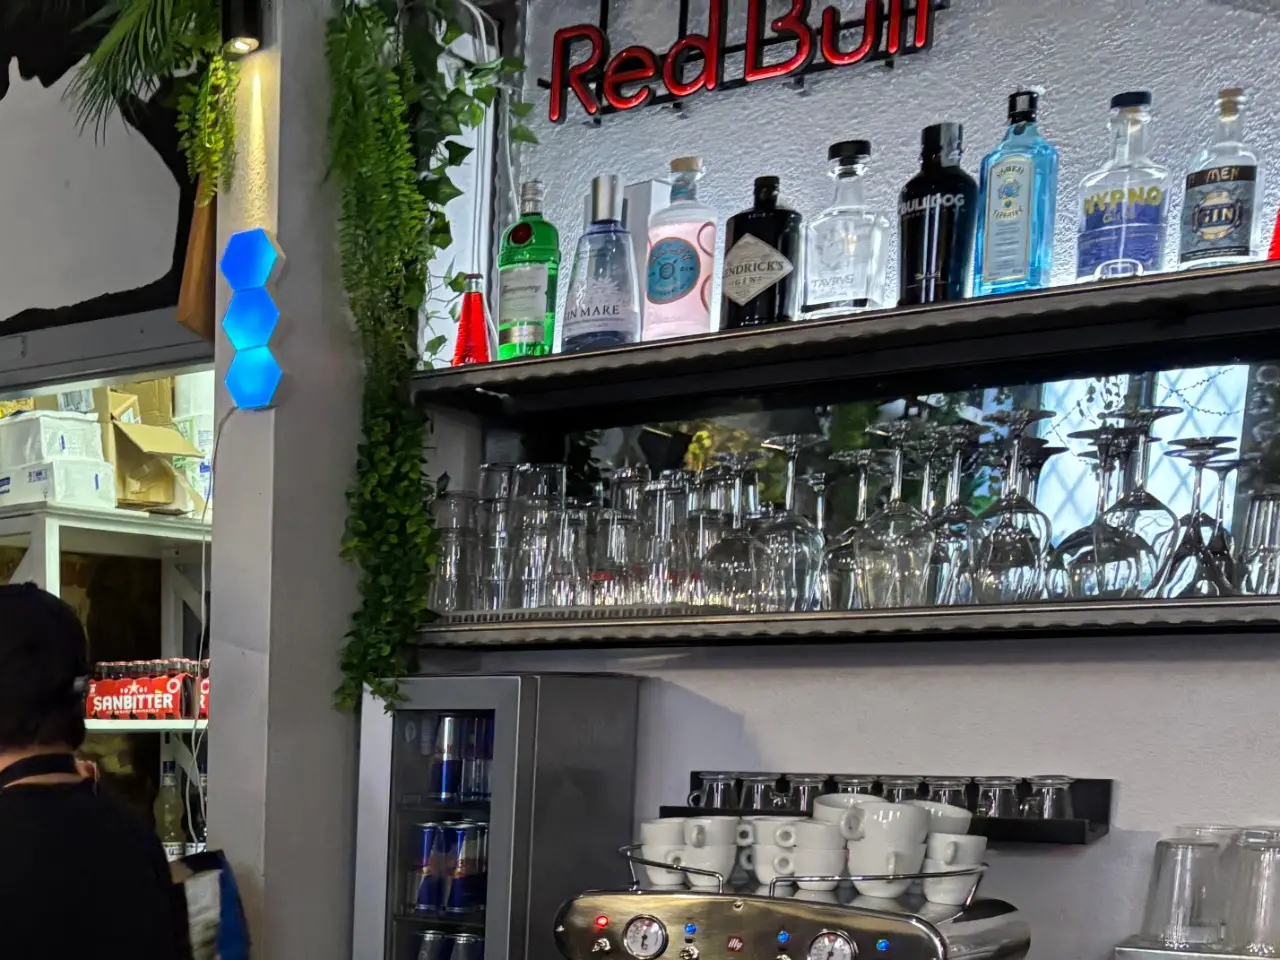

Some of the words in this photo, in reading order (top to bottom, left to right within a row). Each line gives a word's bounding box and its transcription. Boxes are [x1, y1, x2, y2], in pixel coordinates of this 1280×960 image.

[548, 0, 718, 122] Red
[744, 0, 931, 82] Bull
[725, 260, 785, 277] ENDRICK'S
[580, 304, 620, 318] MARE
